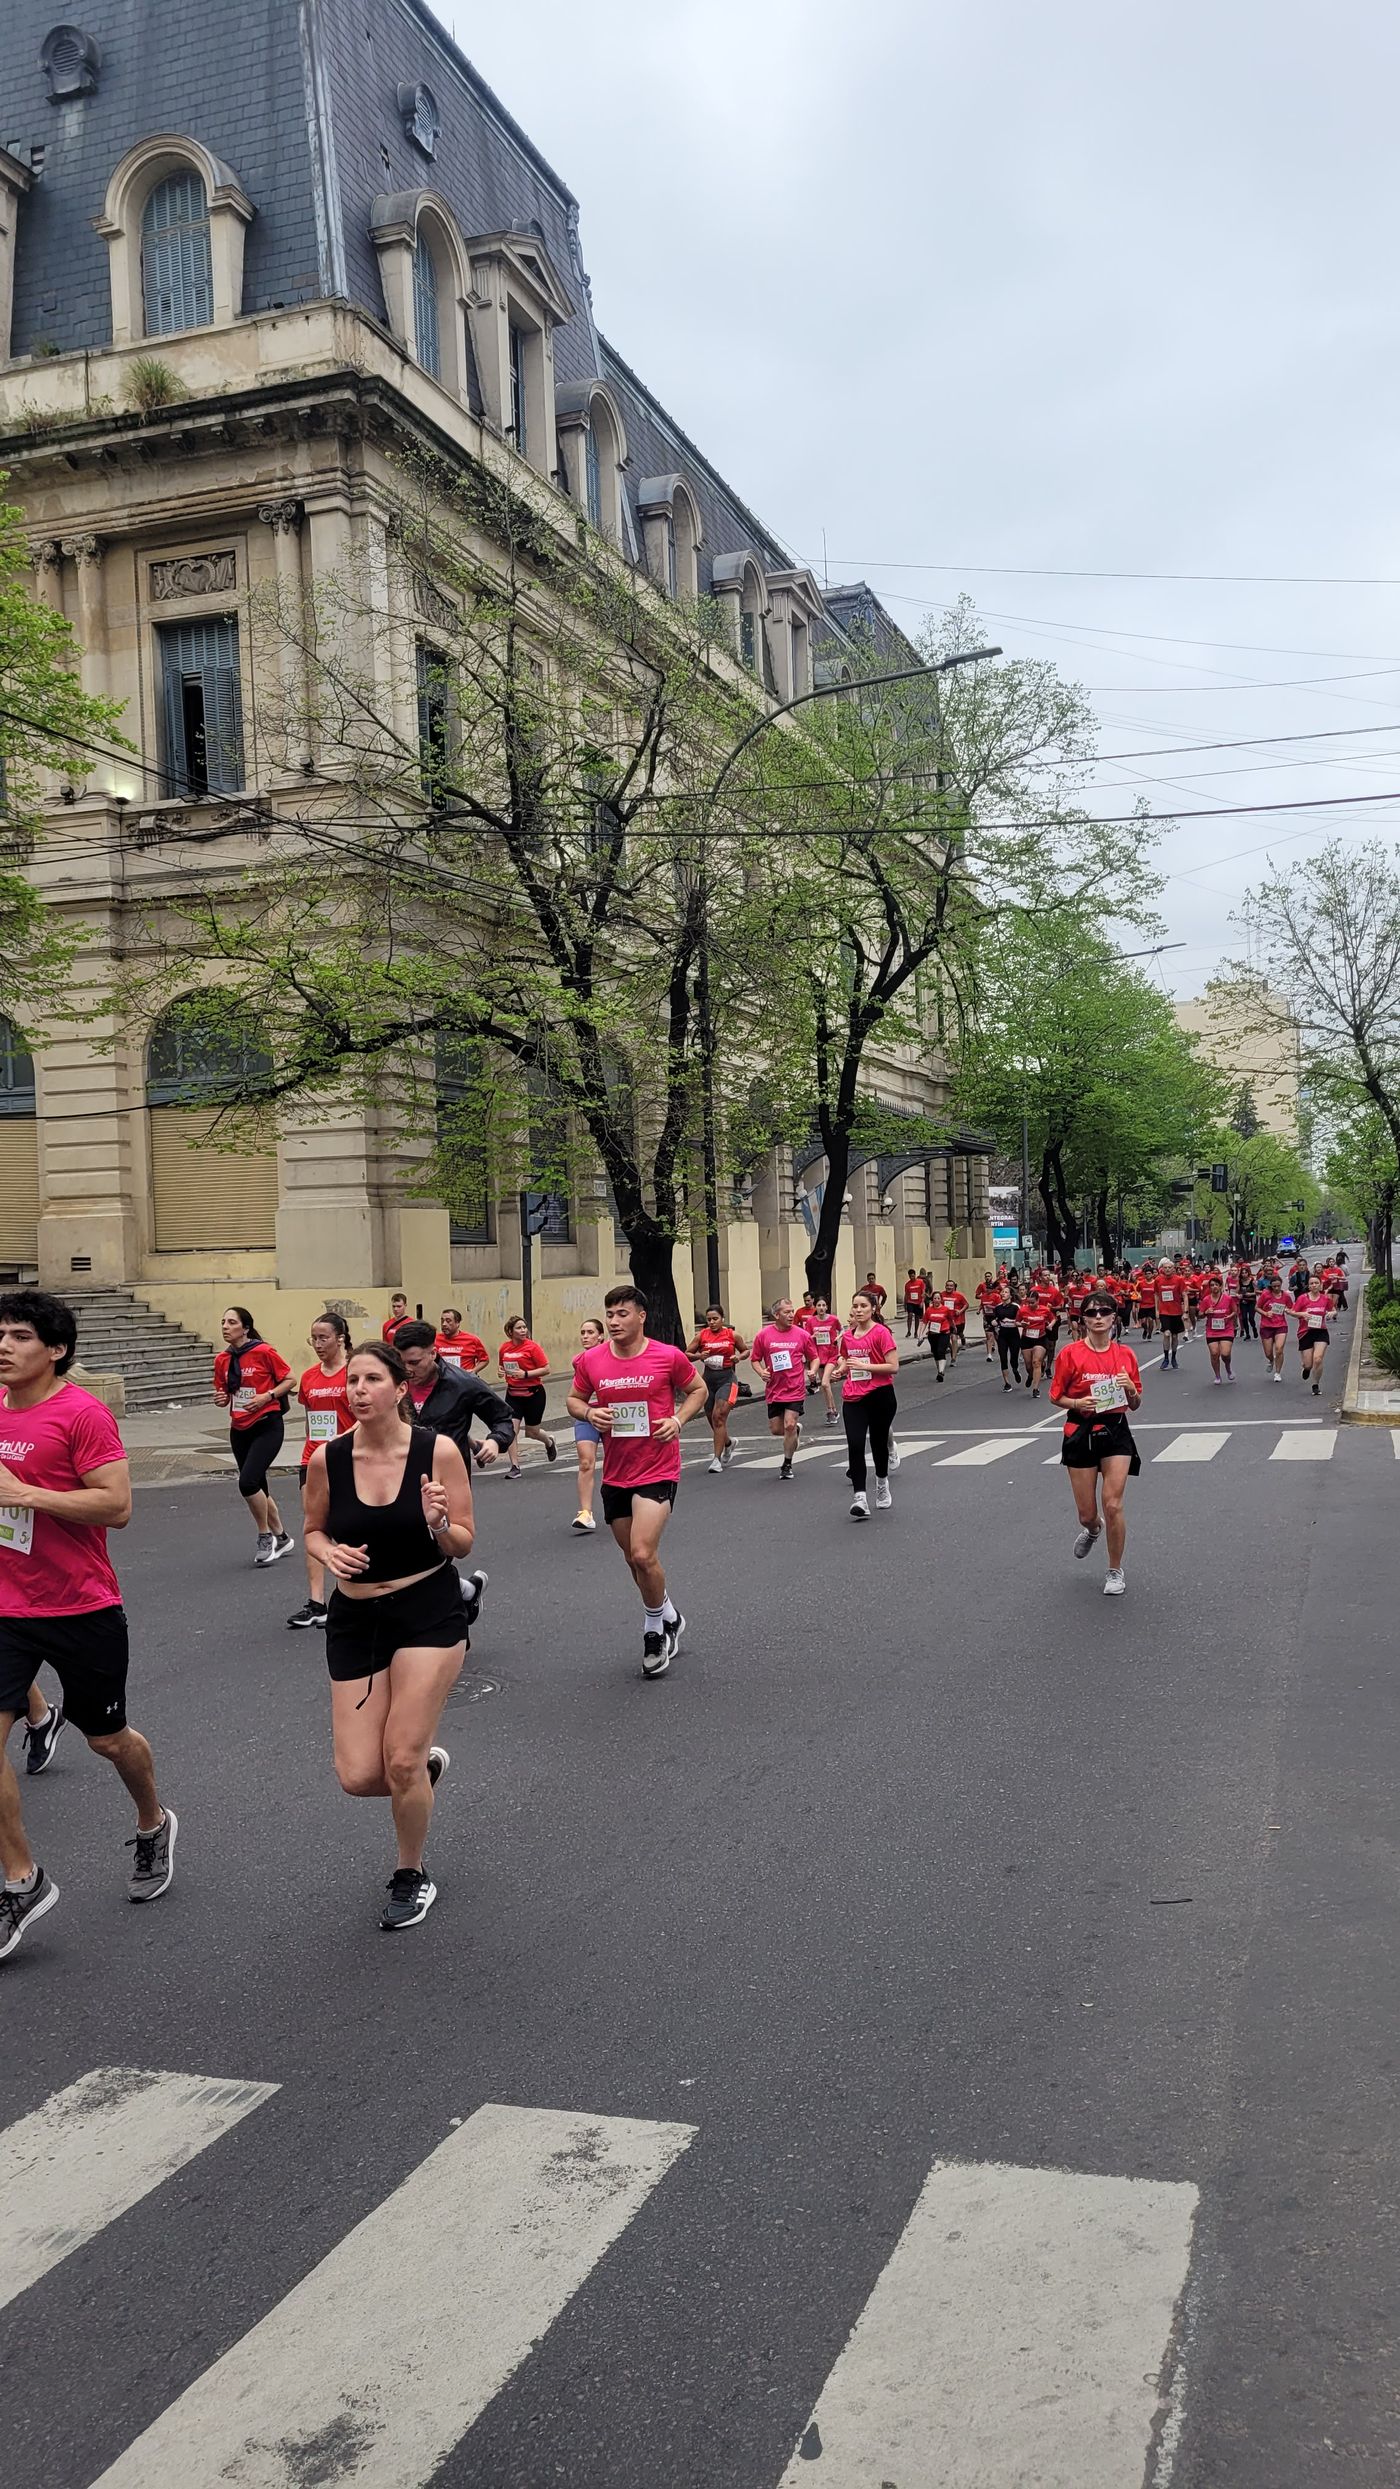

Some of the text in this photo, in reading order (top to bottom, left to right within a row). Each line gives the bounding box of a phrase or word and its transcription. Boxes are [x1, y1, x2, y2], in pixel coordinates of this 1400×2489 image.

[774, 1354, 788, 1362] 355
[613, 1406, 646, 1418] 6078
[310, 1414, 336, 1425] 8950
